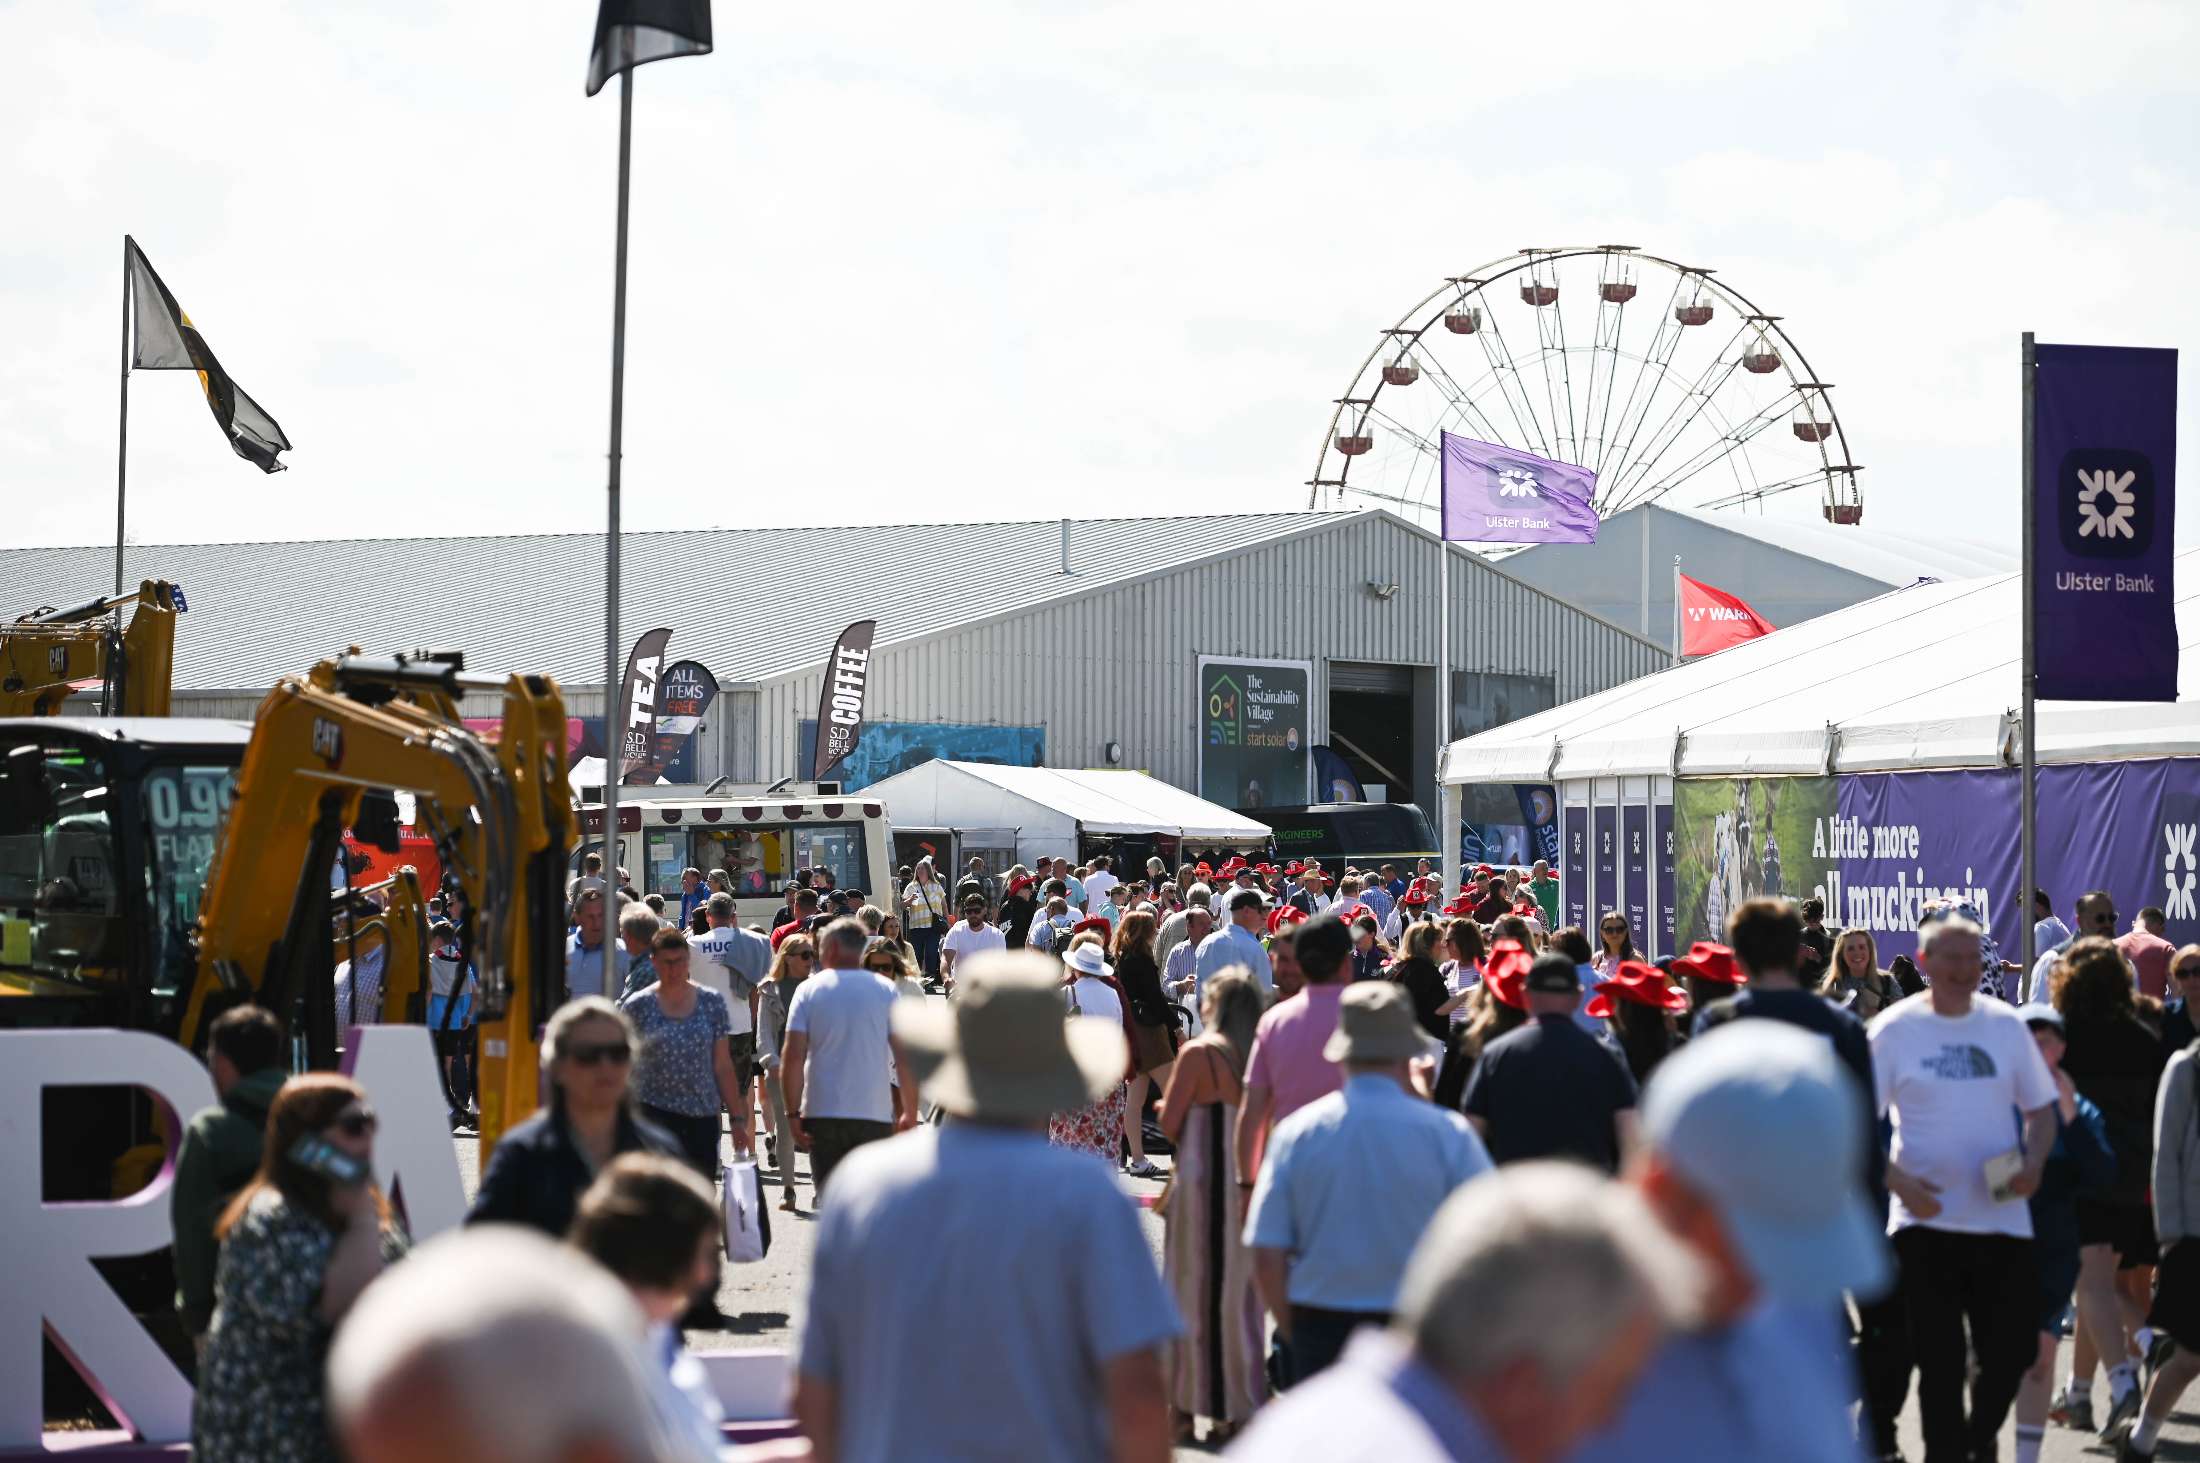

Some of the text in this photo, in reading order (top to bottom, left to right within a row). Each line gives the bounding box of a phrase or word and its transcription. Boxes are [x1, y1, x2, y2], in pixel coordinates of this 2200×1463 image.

[1486, 516, 1550, 529] Ulster Bank
[2056, 571, 2155, 593] Ulster Bank
[671, 669, 697, 682] ALL
[1247, 674, 1263, 688] The
[629, 655, 660, 729] TEA
[665, 685, 704, 699] ITEMS
[830, 645, 869, 726] COFFEE
[1247, 689, 1300, 706] Sustainability
[667, 701, 698, 715] FREE
[1247, 704, 1274, 724] Village
[828, 739, 849, 748] BELL
[1248, 730, 1286, 747] start solar
[625, 743, 647, 752] BELL
[1812, 813, 1920, 859] A little more
